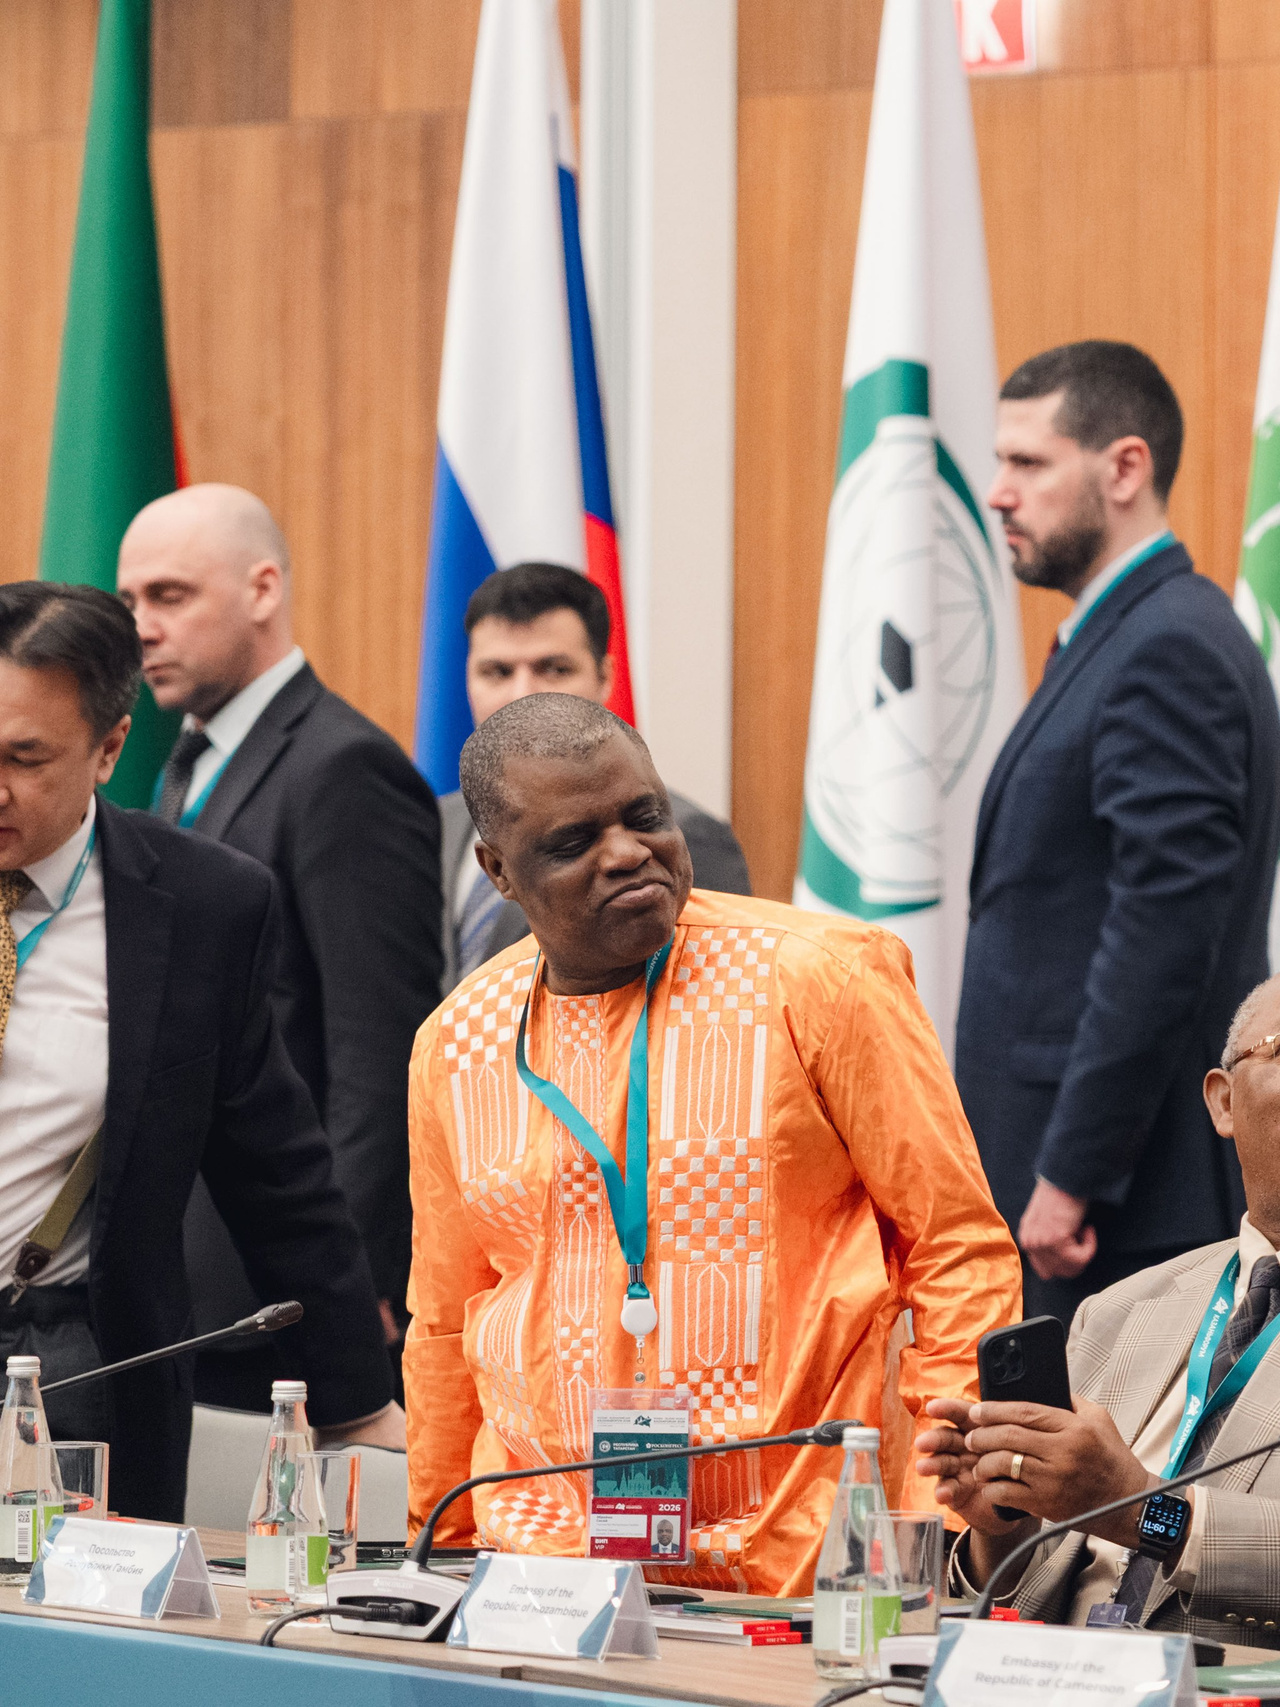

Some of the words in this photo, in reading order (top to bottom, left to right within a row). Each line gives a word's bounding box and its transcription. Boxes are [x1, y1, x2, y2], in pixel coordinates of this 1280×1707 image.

[658, 1503, 681, 1511] 2026
[1143, 1520, 1166, 1533] 09:11
[88, 1543, 136, 1558] Посольство
[112, 1563, 144, 1576] Гамбия
[547, 1586, 558, 1597] of
[558, 1587, 574, 1599] the
[482, 1599, 521, 1613] Republic
[521, 1602, 532, 1612] of
[1000, 1655, 1061, 1671] Embassy
[1063, 1661, 1080, 1671] of
[1082, 1662, 1105, 1674] the
[974, 1671, 1034, 1687] Republic
[1037, 1677, 1053, 1688] of
[1054, 1678, 1126, 1696] Cameroon
